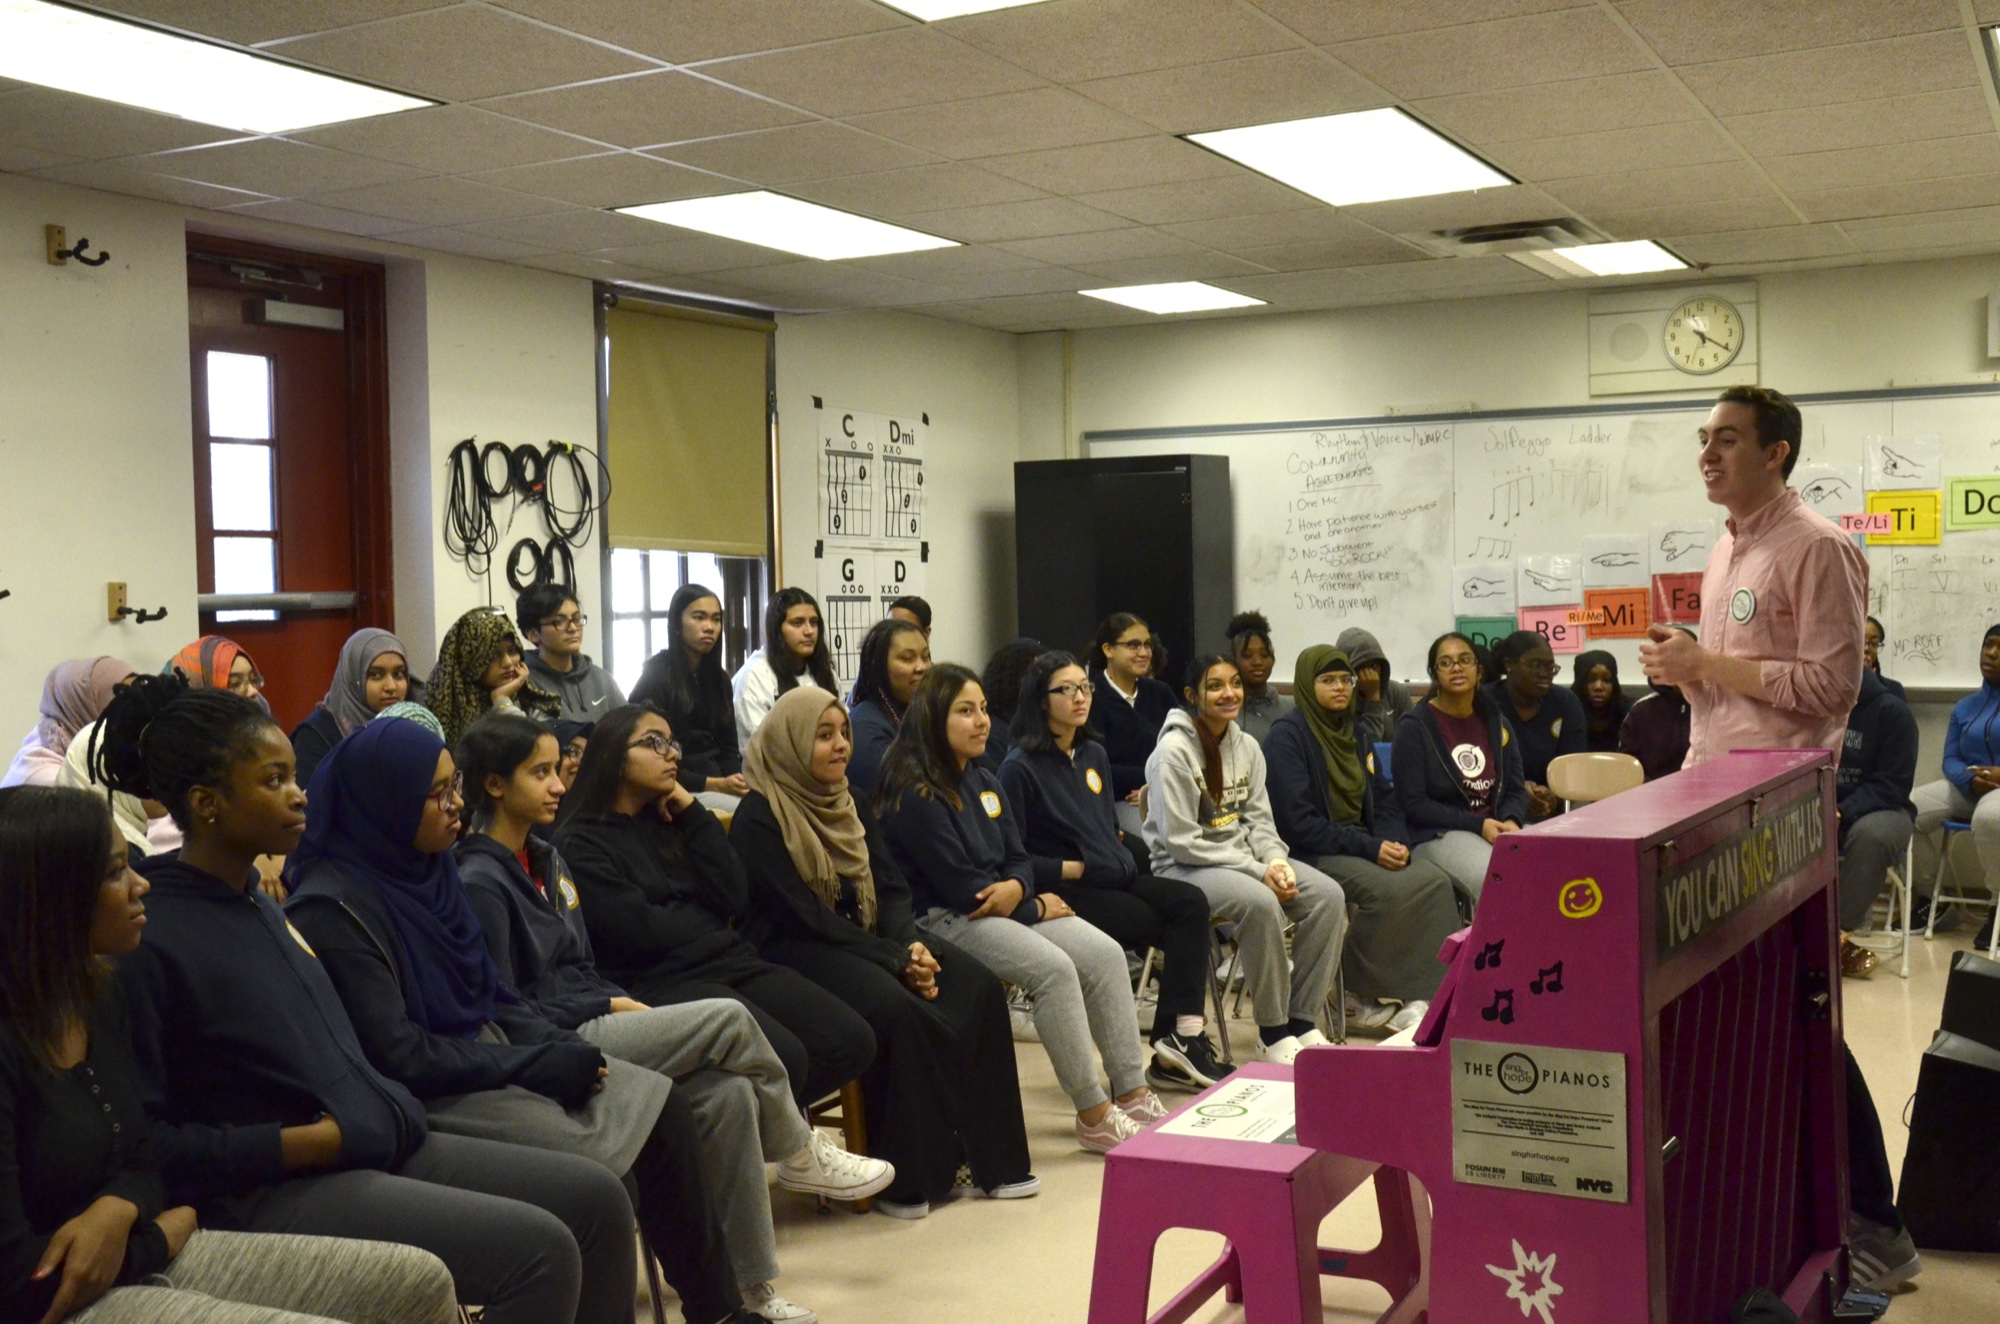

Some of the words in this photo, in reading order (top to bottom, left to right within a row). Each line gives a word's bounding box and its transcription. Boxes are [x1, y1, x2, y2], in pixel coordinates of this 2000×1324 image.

[1683, 308, 1691, 317] 11
[1696, 302, 1705, 312] 12
[1714, 306, 1717, 315] 1
[1673, 319, 1681, 328] 10
[1725, 315, 1730, 324] 2
[1670, 333, 1676, 341] 9
[1727, 328, 1733, 337] 3
[1675, 347, 1680, 355] 8
[1713, 353, 1719, 362] 5
[1686, 355, 1690, 364] 7
[1699, 358, 1704, 367] 6
[842, 413, 855, 438] C
[1371, 429, 1401, 447] Voice
[1569, 423, 1613, 445] Ladder
[1297, 499, 1318, 512] One
[1298, 517, 1323, 531] Have
[1326, 513, 1371, 530] patience
[1374, 508, 1398, 521] with
[1842, 515, 1889, 531] Te/Li
[1890, 507, 1916, 532] Ti
[1304, 533, 1322, 542] and
[1328, 528, 1343, 538] one
[1344, 523, 1383, 534] another
[1302, 549, 1318, 561] No
[842, 558, 854, 582] G
[894, 560, 906, 583] D
[1304, 568, 1353, 584] Assume
[1358, 570, 1375, 582] the
[1379, 571, 1400, 582] best
[1672, 588, 1700, 611] Fa
[1339, 597, 1361, 618] give
[1602, 603, 1635, 627] Mi
[1535, 621, 1567, 642] Re
[1665, 867, 1703, 948] YOU
[1705, 846, 1740, 921] CAN
[1774, 804, 1807, 874] WITH
[1806, 796, 1823, 853] US
[1464, 1061, 1493, 1078] THE
[1542, 1068, 1611, 1089] PIANOS
[1505, 1062, 1522, 1075] sing
[1503, 1073, 1533, 1085] hope
[1511, 1149, 1570, 1164] singforhope.org
[1465, 1163, 1492, 1174] FOSUN
[1576, 1177, 1614, 1194] NYC
